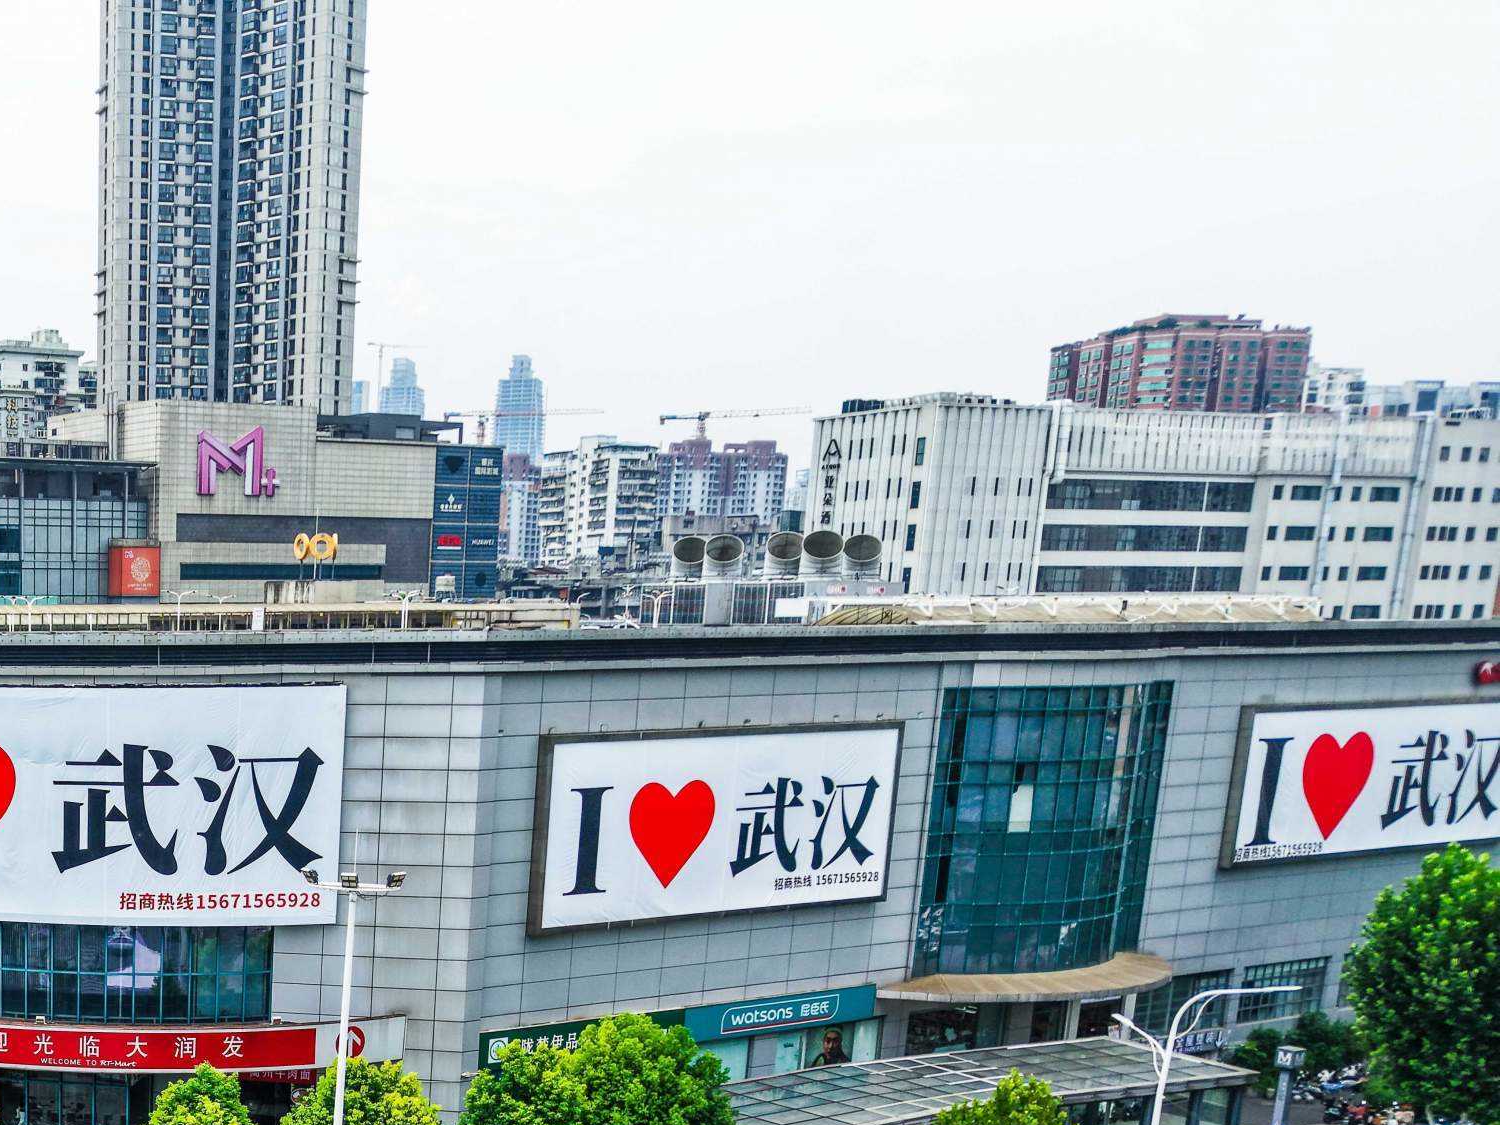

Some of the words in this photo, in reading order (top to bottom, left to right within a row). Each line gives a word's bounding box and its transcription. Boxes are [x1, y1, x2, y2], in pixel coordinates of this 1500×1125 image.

[1244, 736, 1295, 848] I
[51, 743, 324, 875] 武汉
[562, 786, 614, 897] I
[730, 775, 881, 878] 武汉
[816, 871, 879, 886] 15671565928
[119, 892, 321, 912] 招商热线15671565928
[731, 1007, 793, 1026] watsons
[40, 1057, 81, 1067] WELCOME
[86, 1059, 97, 1067] TO
[100, 1059, 137, 1069] RT-Mart
